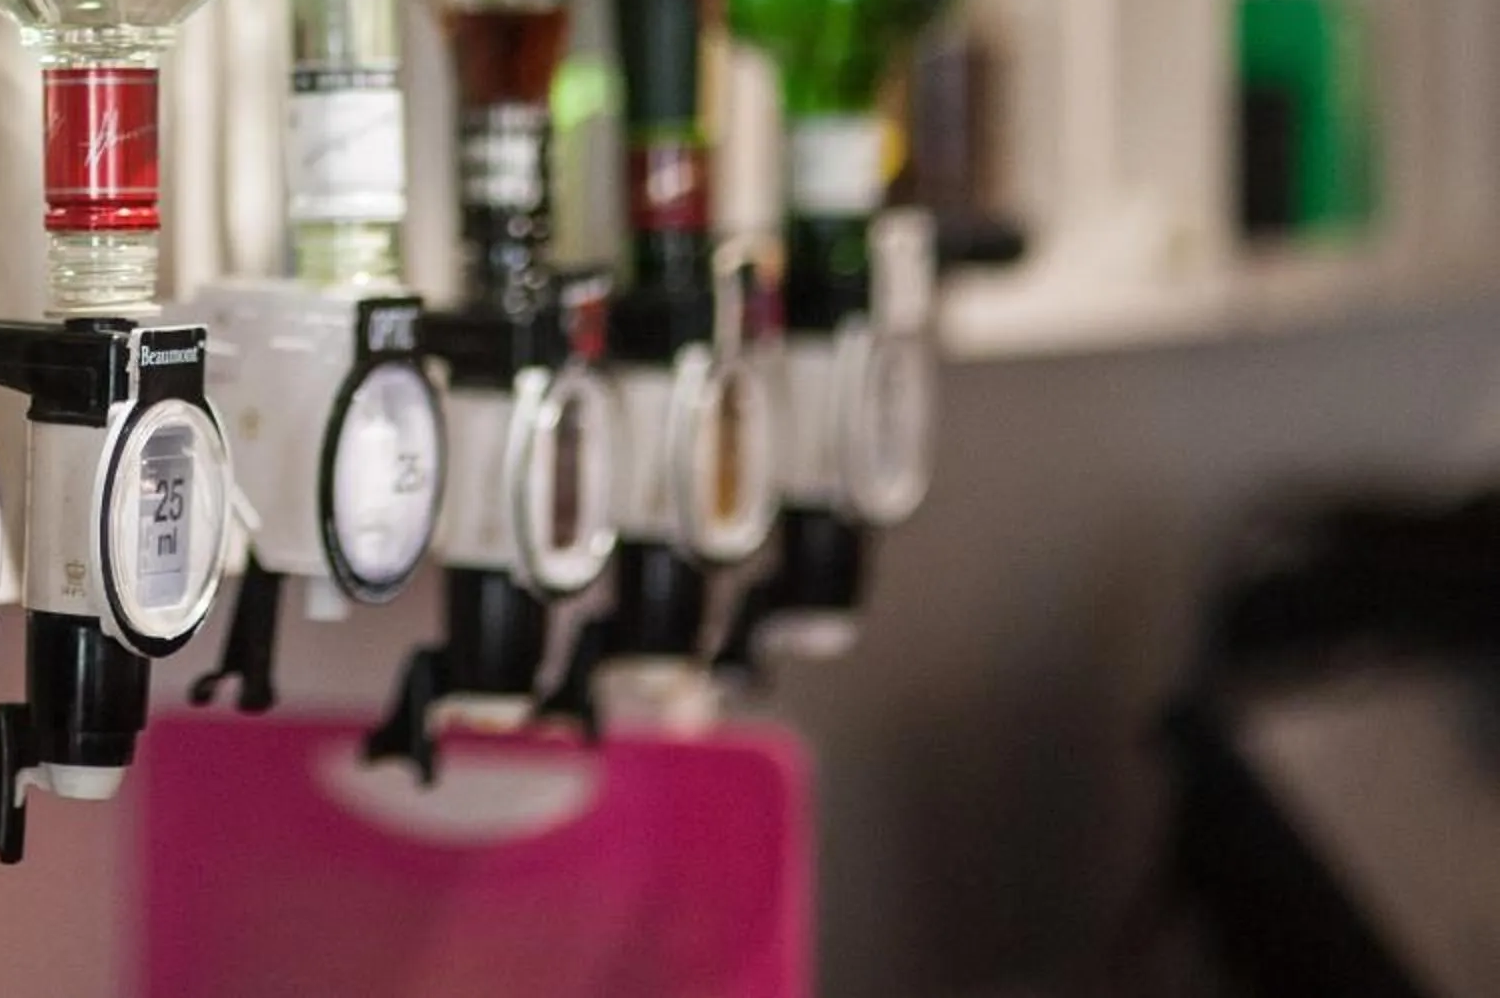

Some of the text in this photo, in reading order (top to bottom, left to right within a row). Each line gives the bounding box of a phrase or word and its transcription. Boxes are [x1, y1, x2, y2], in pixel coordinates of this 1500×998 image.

[141, 345, 198, 367] Beaumont
[154, 477, 185, 523] 25
[157, 526, 178, 556] ml
